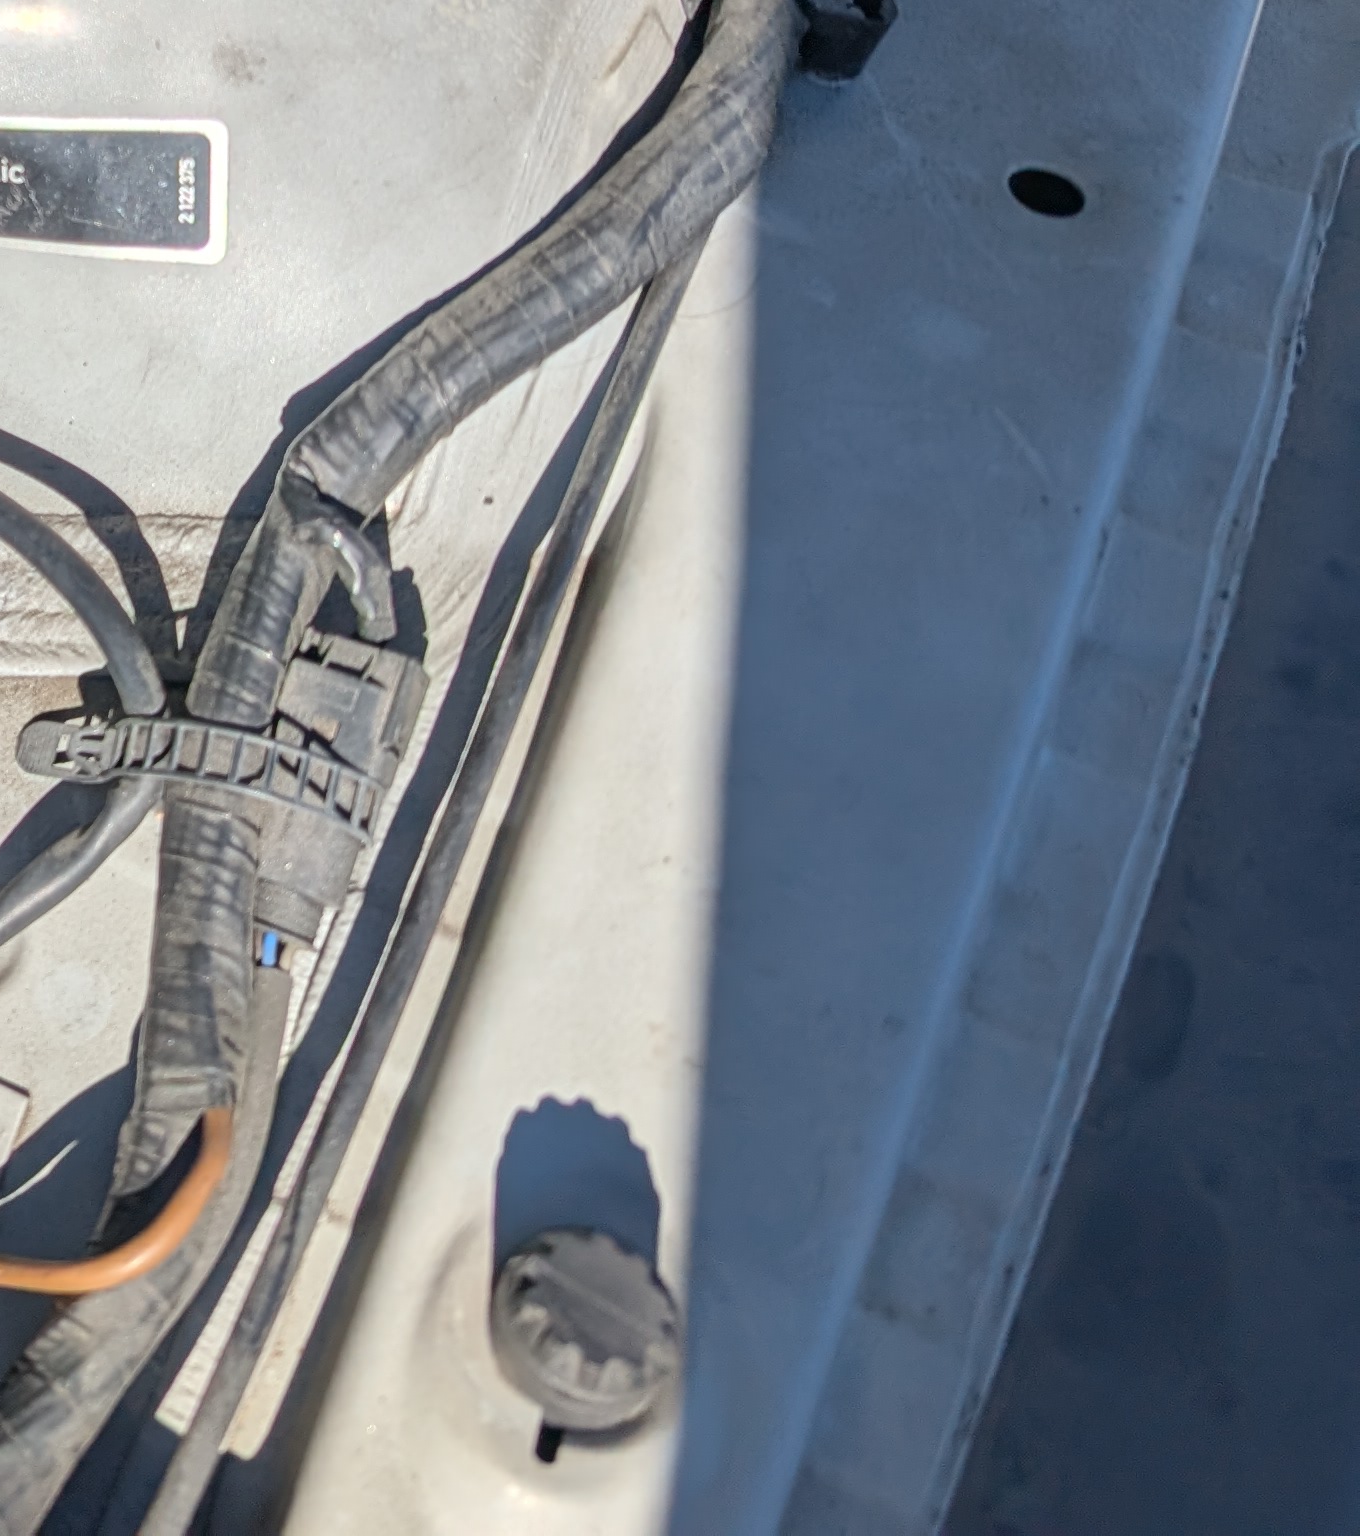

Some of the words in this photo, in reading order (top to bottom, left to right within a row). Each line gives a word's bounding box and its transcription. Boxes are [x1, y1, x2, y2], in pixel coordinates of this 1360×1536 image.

[177, 157, 196, 185] 375
[177, 186, 196, 211] 122
[177, 212, 196, 224] 2
